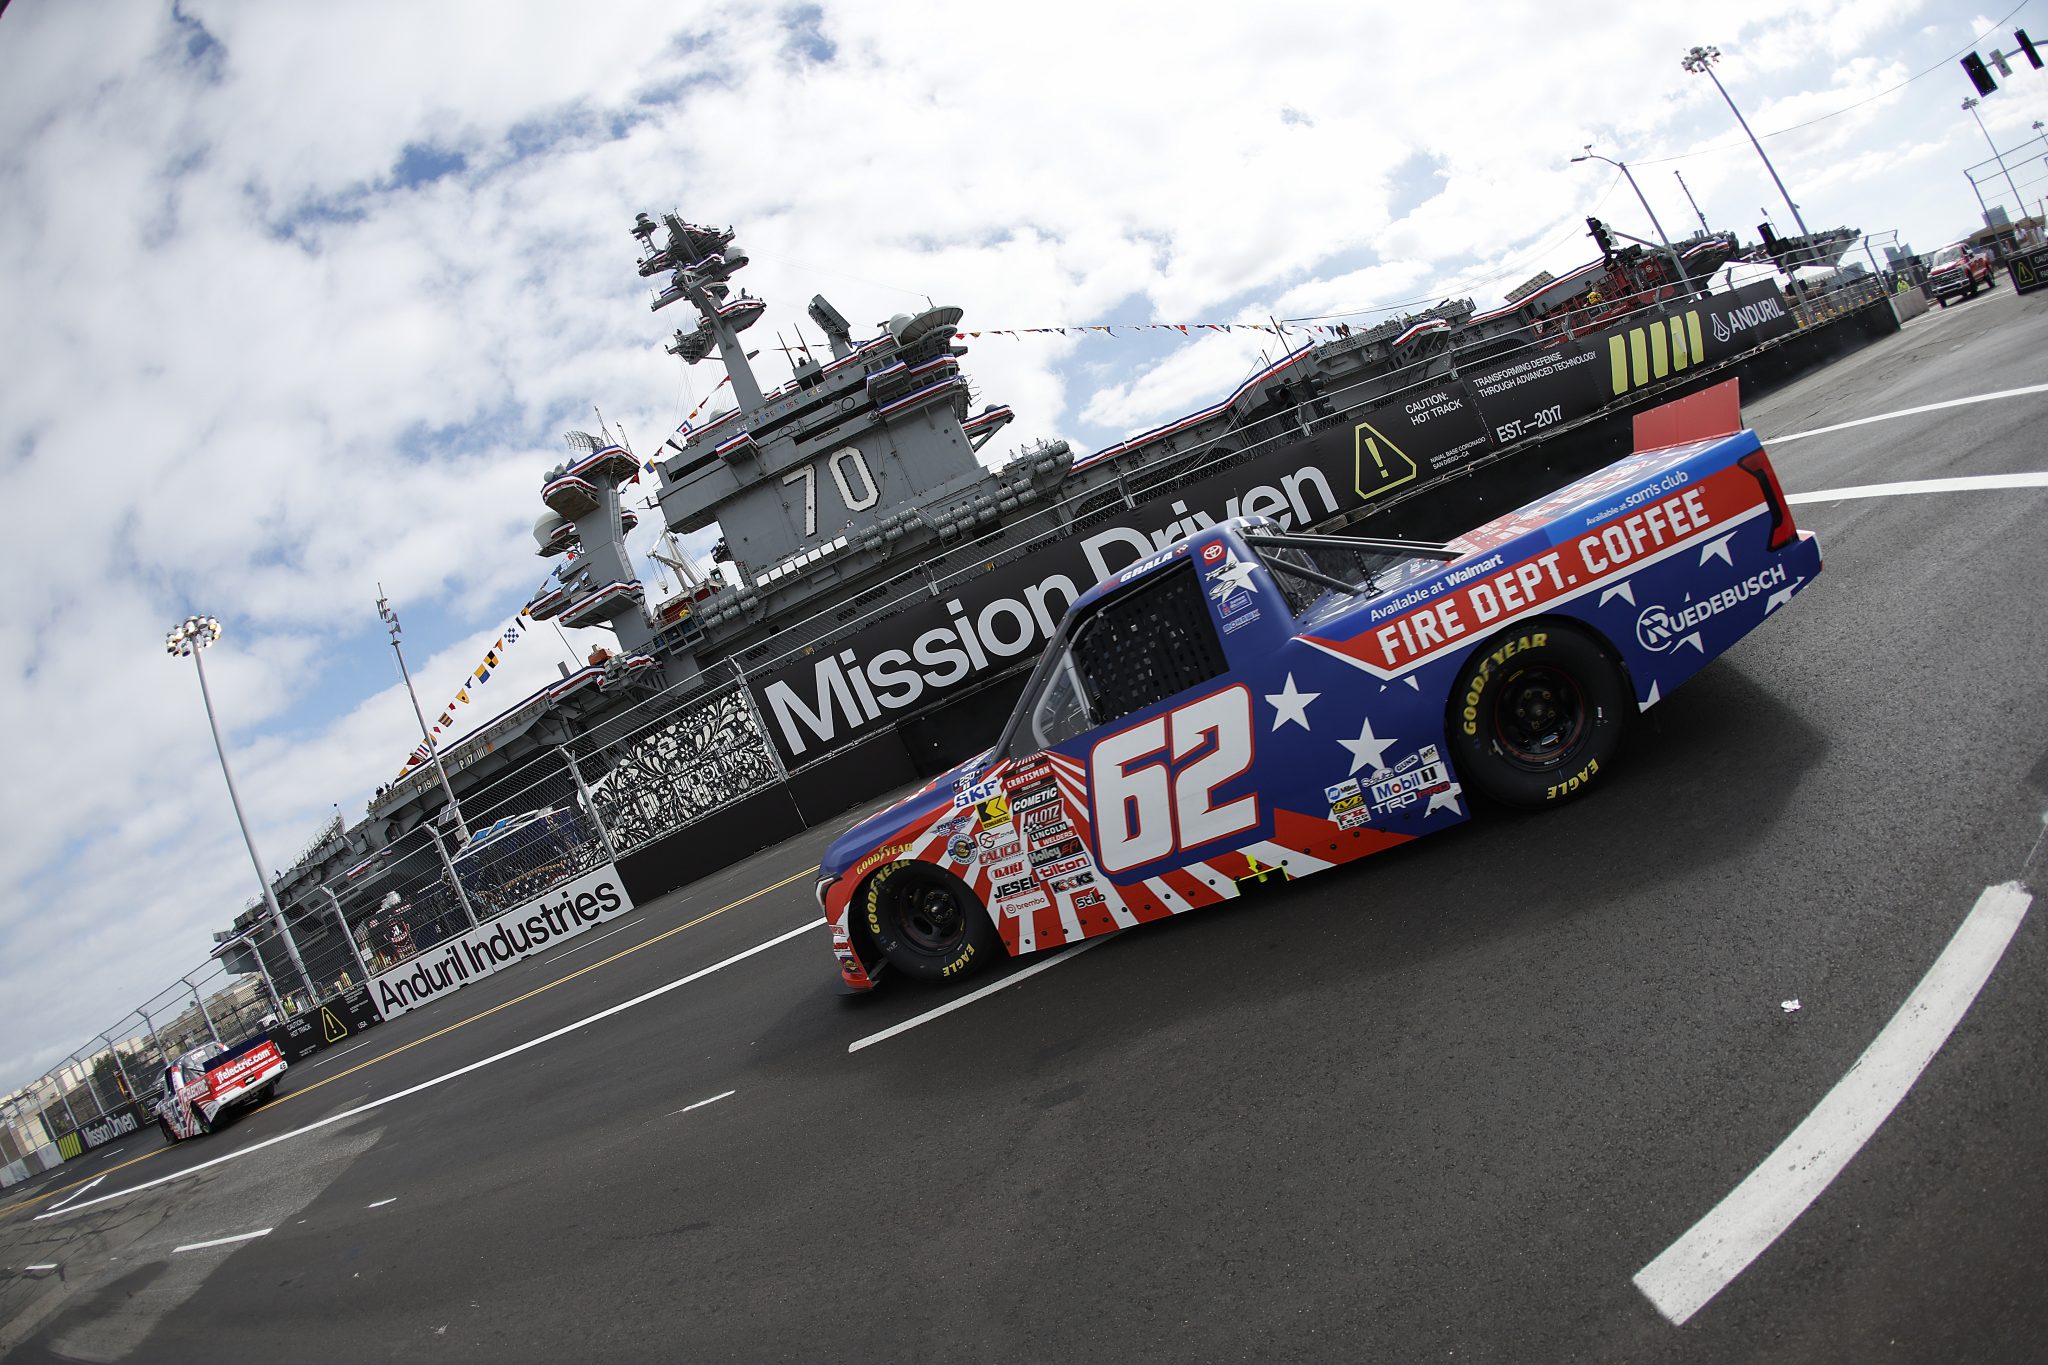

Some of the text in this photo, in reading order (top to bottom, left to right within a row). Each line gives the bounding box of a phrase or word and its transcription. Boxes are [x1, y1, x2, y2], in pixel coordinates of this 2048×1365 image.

[1728, 297, 1786, 334] ANDURIL
[1473, 351, 1563, 388] TRANSFORMING DEFENSE
[1477, 350, 1597, 398] THROUGH ADVANCED TECHNOLOGY
[1405, 391, 1449, 415] CAUTION:
[1410, 399, 1463, 426] HOT TRACK
[1430, 436, 1486, 463] NAVAL BASE CORONADO
[781, 445, 881, 538] 70
[1586, 505, 1619, 526] Available
[1618, 502, 1628, 512] at
[1661, 470, 1688, 491] club
[1120, 551, 1173, 582] GRALA
[1371, 552, 1504, 622] Available at Walmart
[1375, 598, 1466, 665] FIRE
[1468, 556, 1578, 624] DEPT.
[1638, 563, 1786, 648] RUEDEBUSCH
[764, 573, 1087, 755] Mission
[1006, 765, 1050, 788] CRAFTSMAN
[1091, 684, 1260, 874] 62
[1376, 772, 1420, 799] Mobil
[1546, 758, 1599, 799] EAGLE
[956, 780, 997, 808] SKF
[1013, 786, 1057, 811] COMETIC
[1371, 791, 1418, 814] TRD
[1027, 803, 1060, 826] KLOTZ
[1031, 823, 1067, 841] LINCOLN
[1042, 830, 1074, 845] WELDERS
[856, 843, 913, 875] GOODYEAR
[979, 842, 1021, 865] CALICO
[1030, 847, 1062, 864] Holley
[1039, 857, 1087, 877] tilton
[994, 876, 1039, 898] JESEL
[1016, 897, 1045, 909] brembo
[379, 944, 469, 1015] Anduril
[461, 882, 621, 974] Industries
[942, 943, 975, 977] EAGLE
[215, 1049, 271, 1084] jfelectric.com
[81, 1112, 138, 1148] Mission Driven
